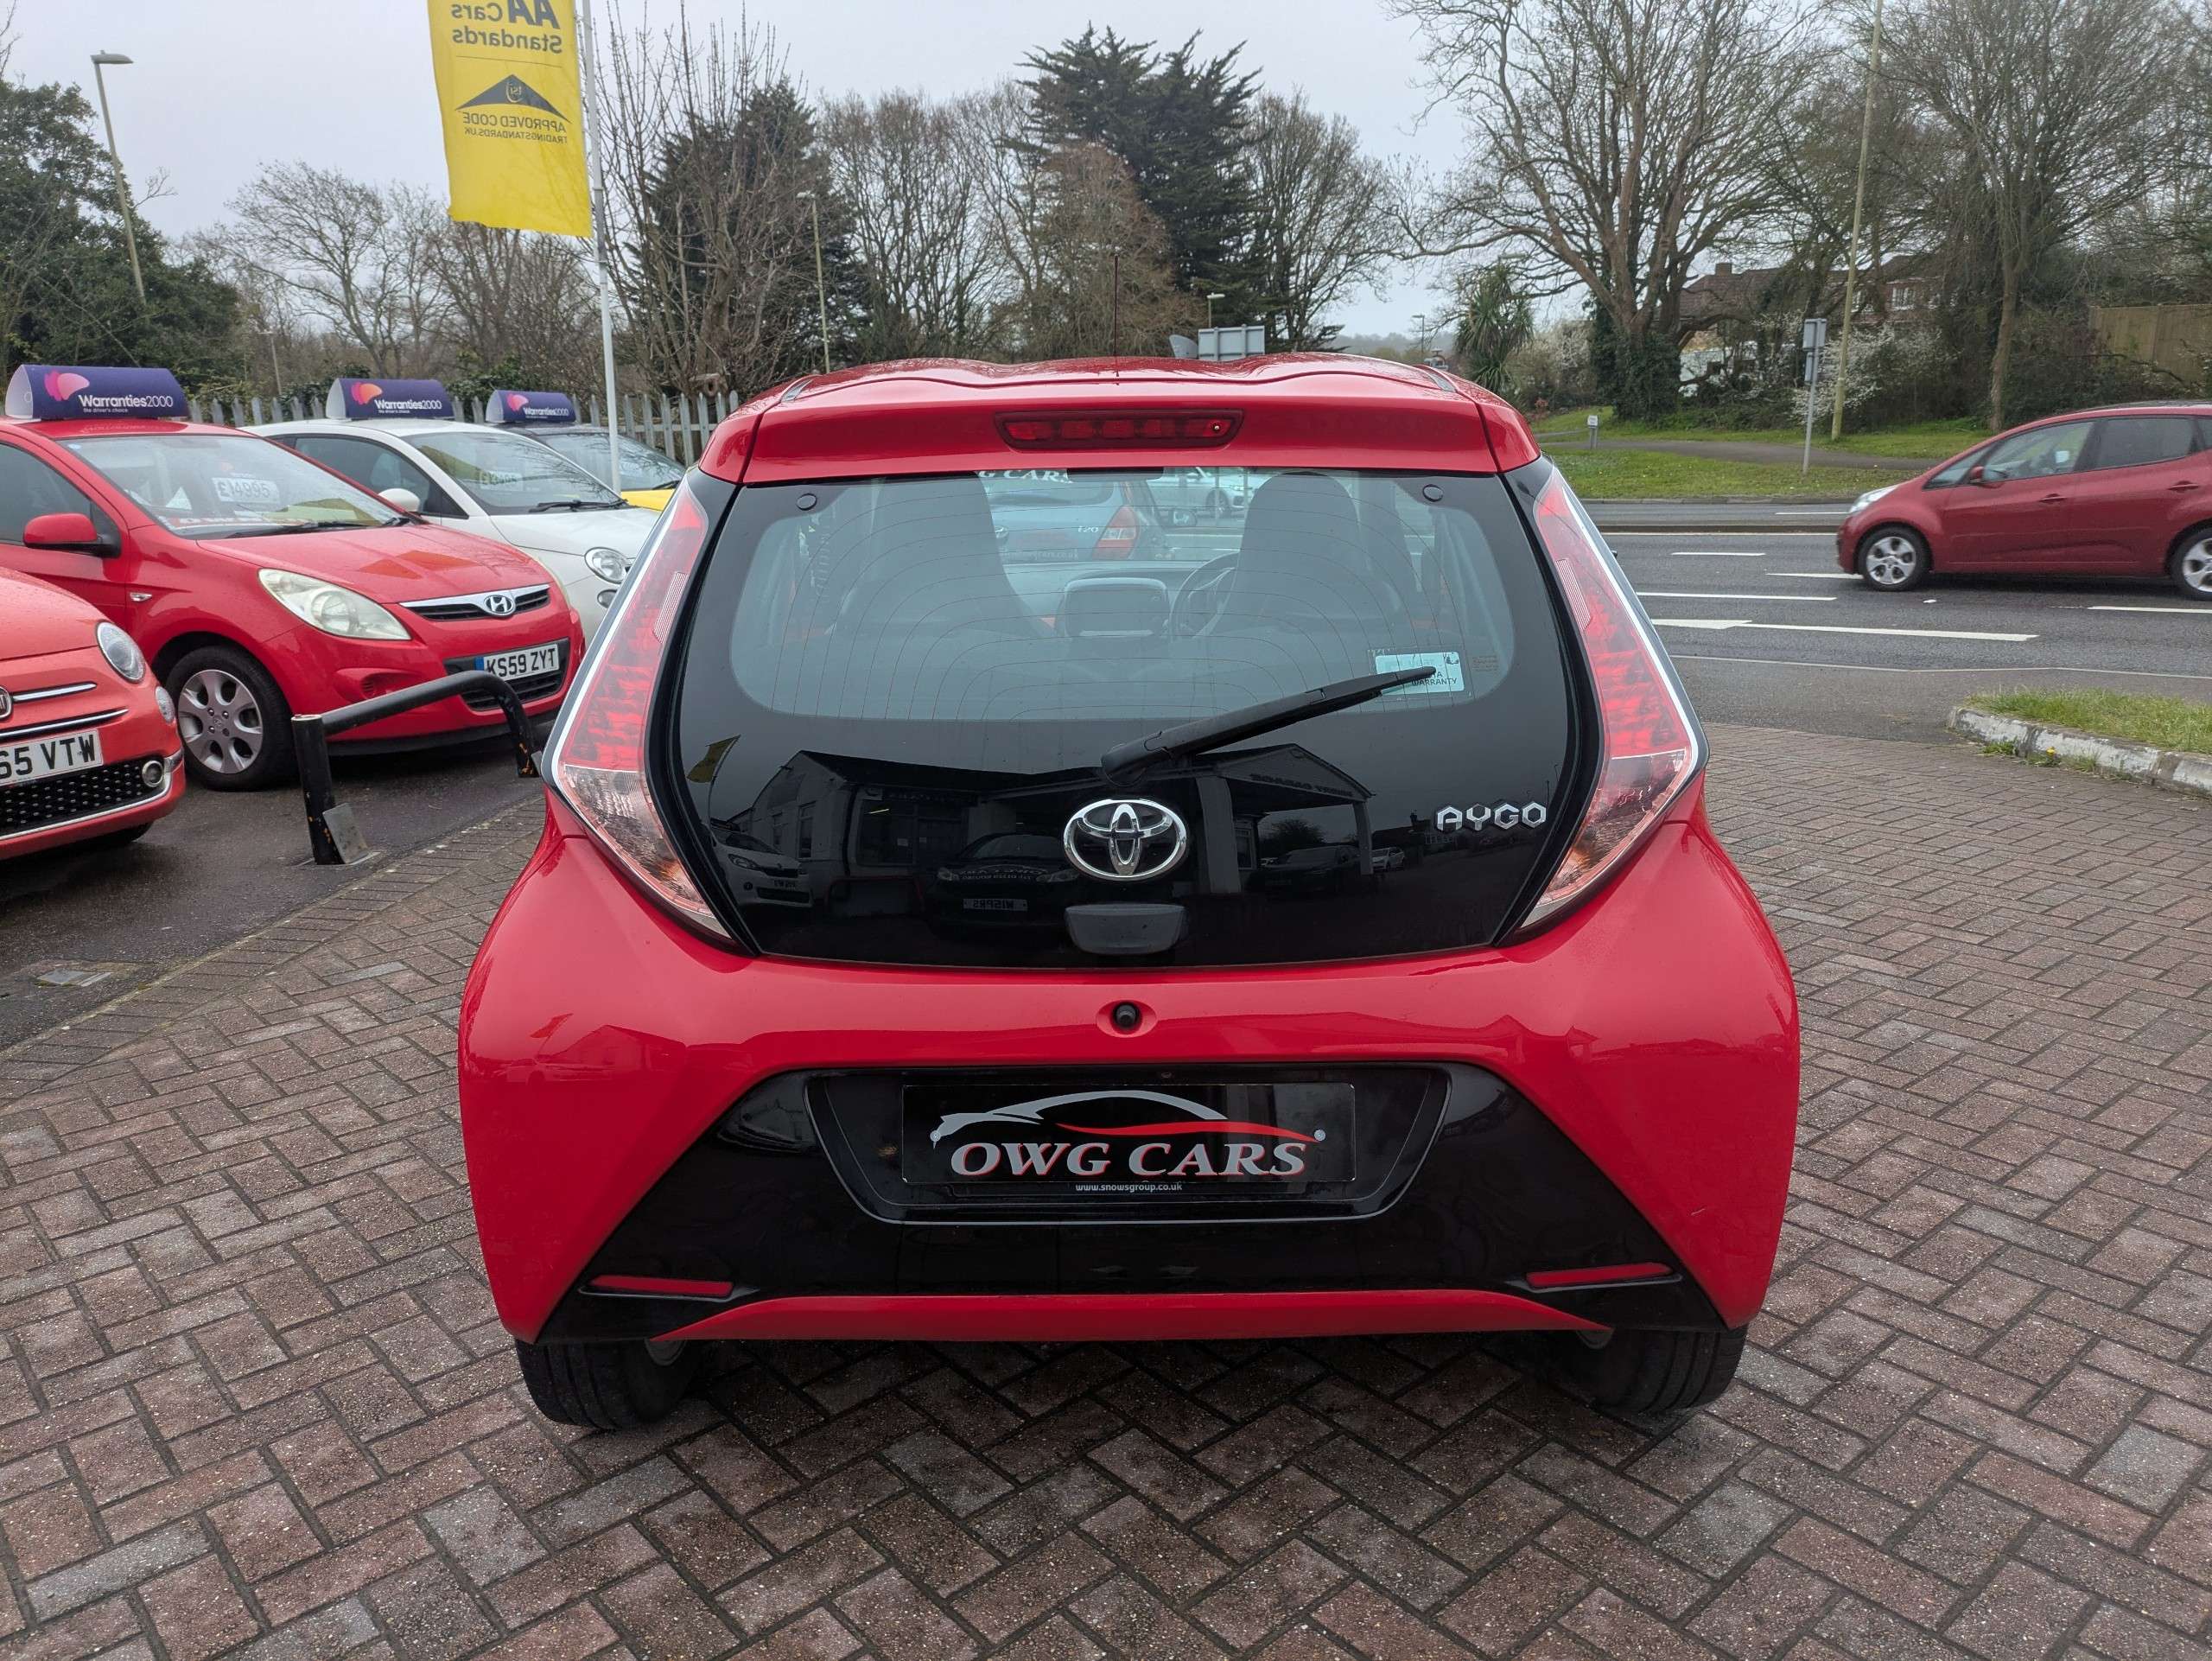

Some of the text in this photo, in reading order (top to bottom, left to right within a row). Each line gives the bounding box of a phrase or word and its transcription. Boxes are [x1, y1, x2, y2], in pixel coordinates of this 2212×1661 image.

[78, 394, 174, 408] Warranties2000
[373, 398, 442, 410] Warranties2000
[522, 406, 569, 417] Warranties2000
[486, 647, 556, 678] KS59 ZYT
[40, 734, 96, 771] VTW
[1436, 801, 1547, 831] AYGO
[950, 1142, 1307, 1176] OWG CARS
[1074, 1181, 1184, 1194] www.snowsgroup.co.uk
